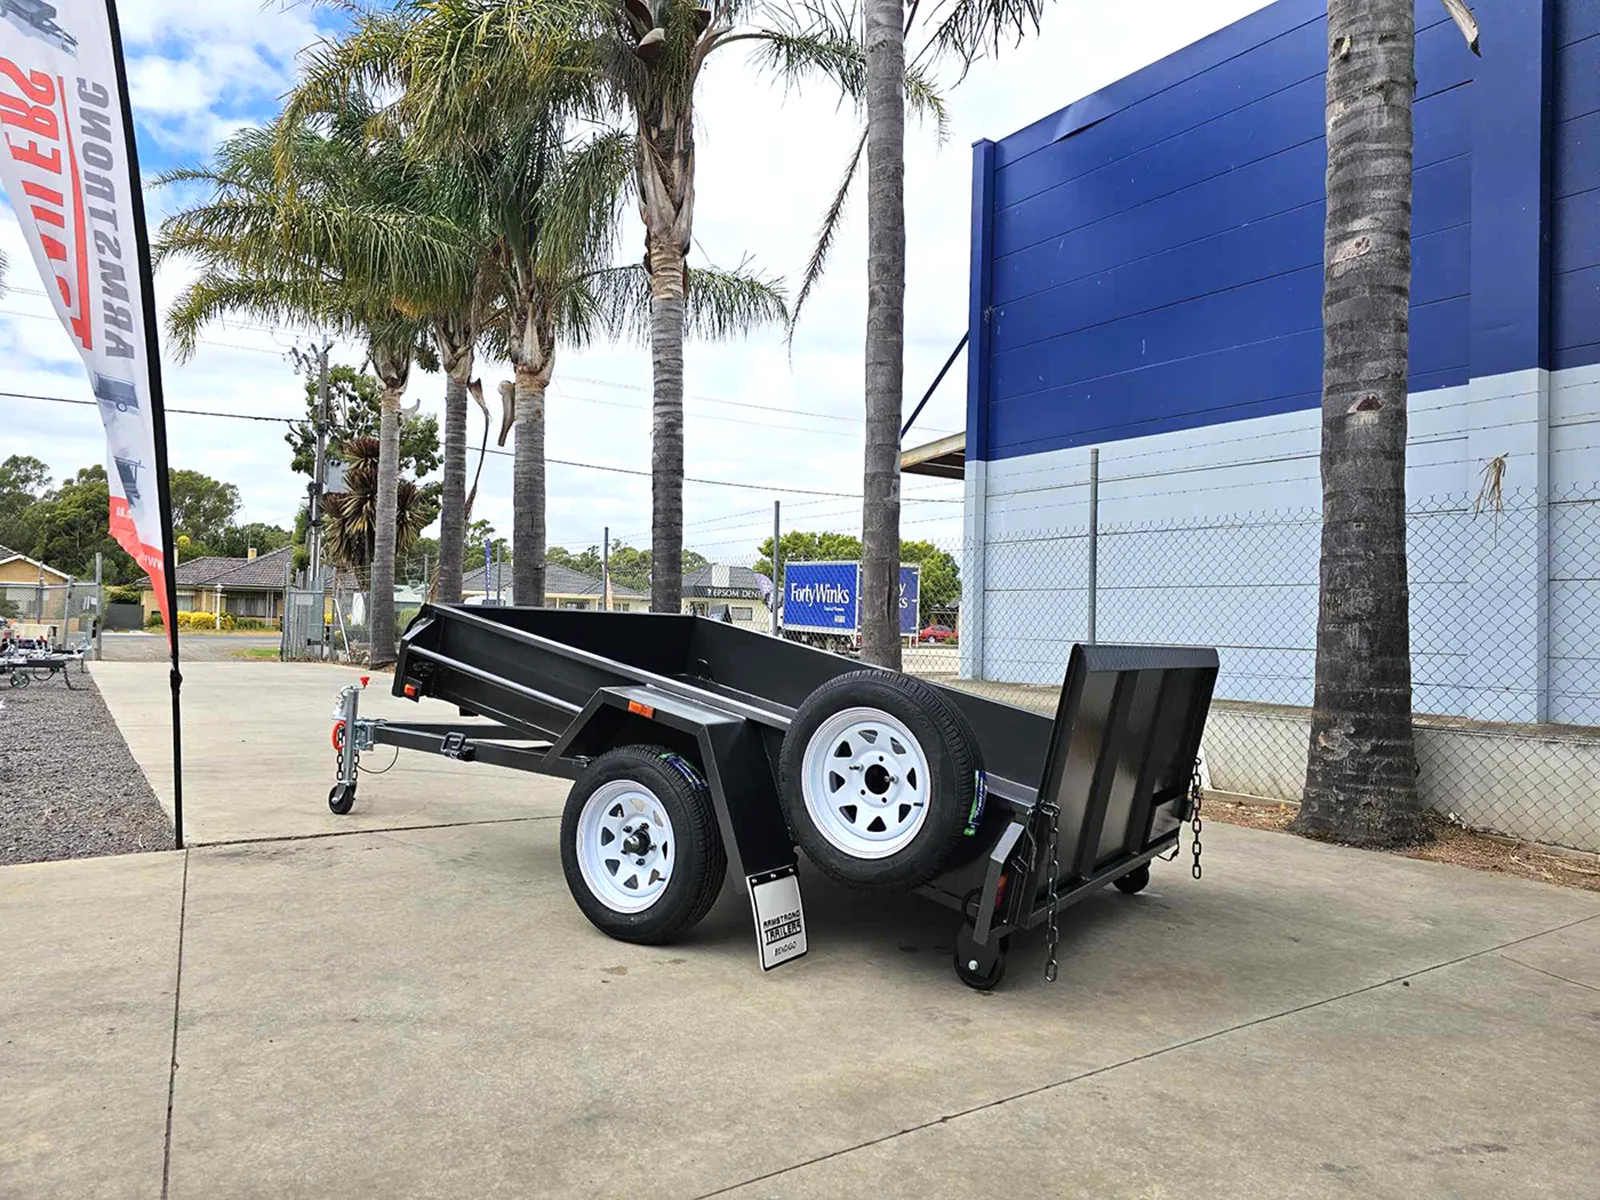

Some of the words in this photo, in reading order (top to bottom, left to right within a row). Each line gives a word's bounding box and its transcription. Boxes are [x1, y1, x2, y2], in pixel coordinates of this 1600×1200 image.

[713, 588, 739, 598] EPSOM
[763, 909, 801, 929] ARMSTRONG
[764, 918, 802, 945] TRAILERS
